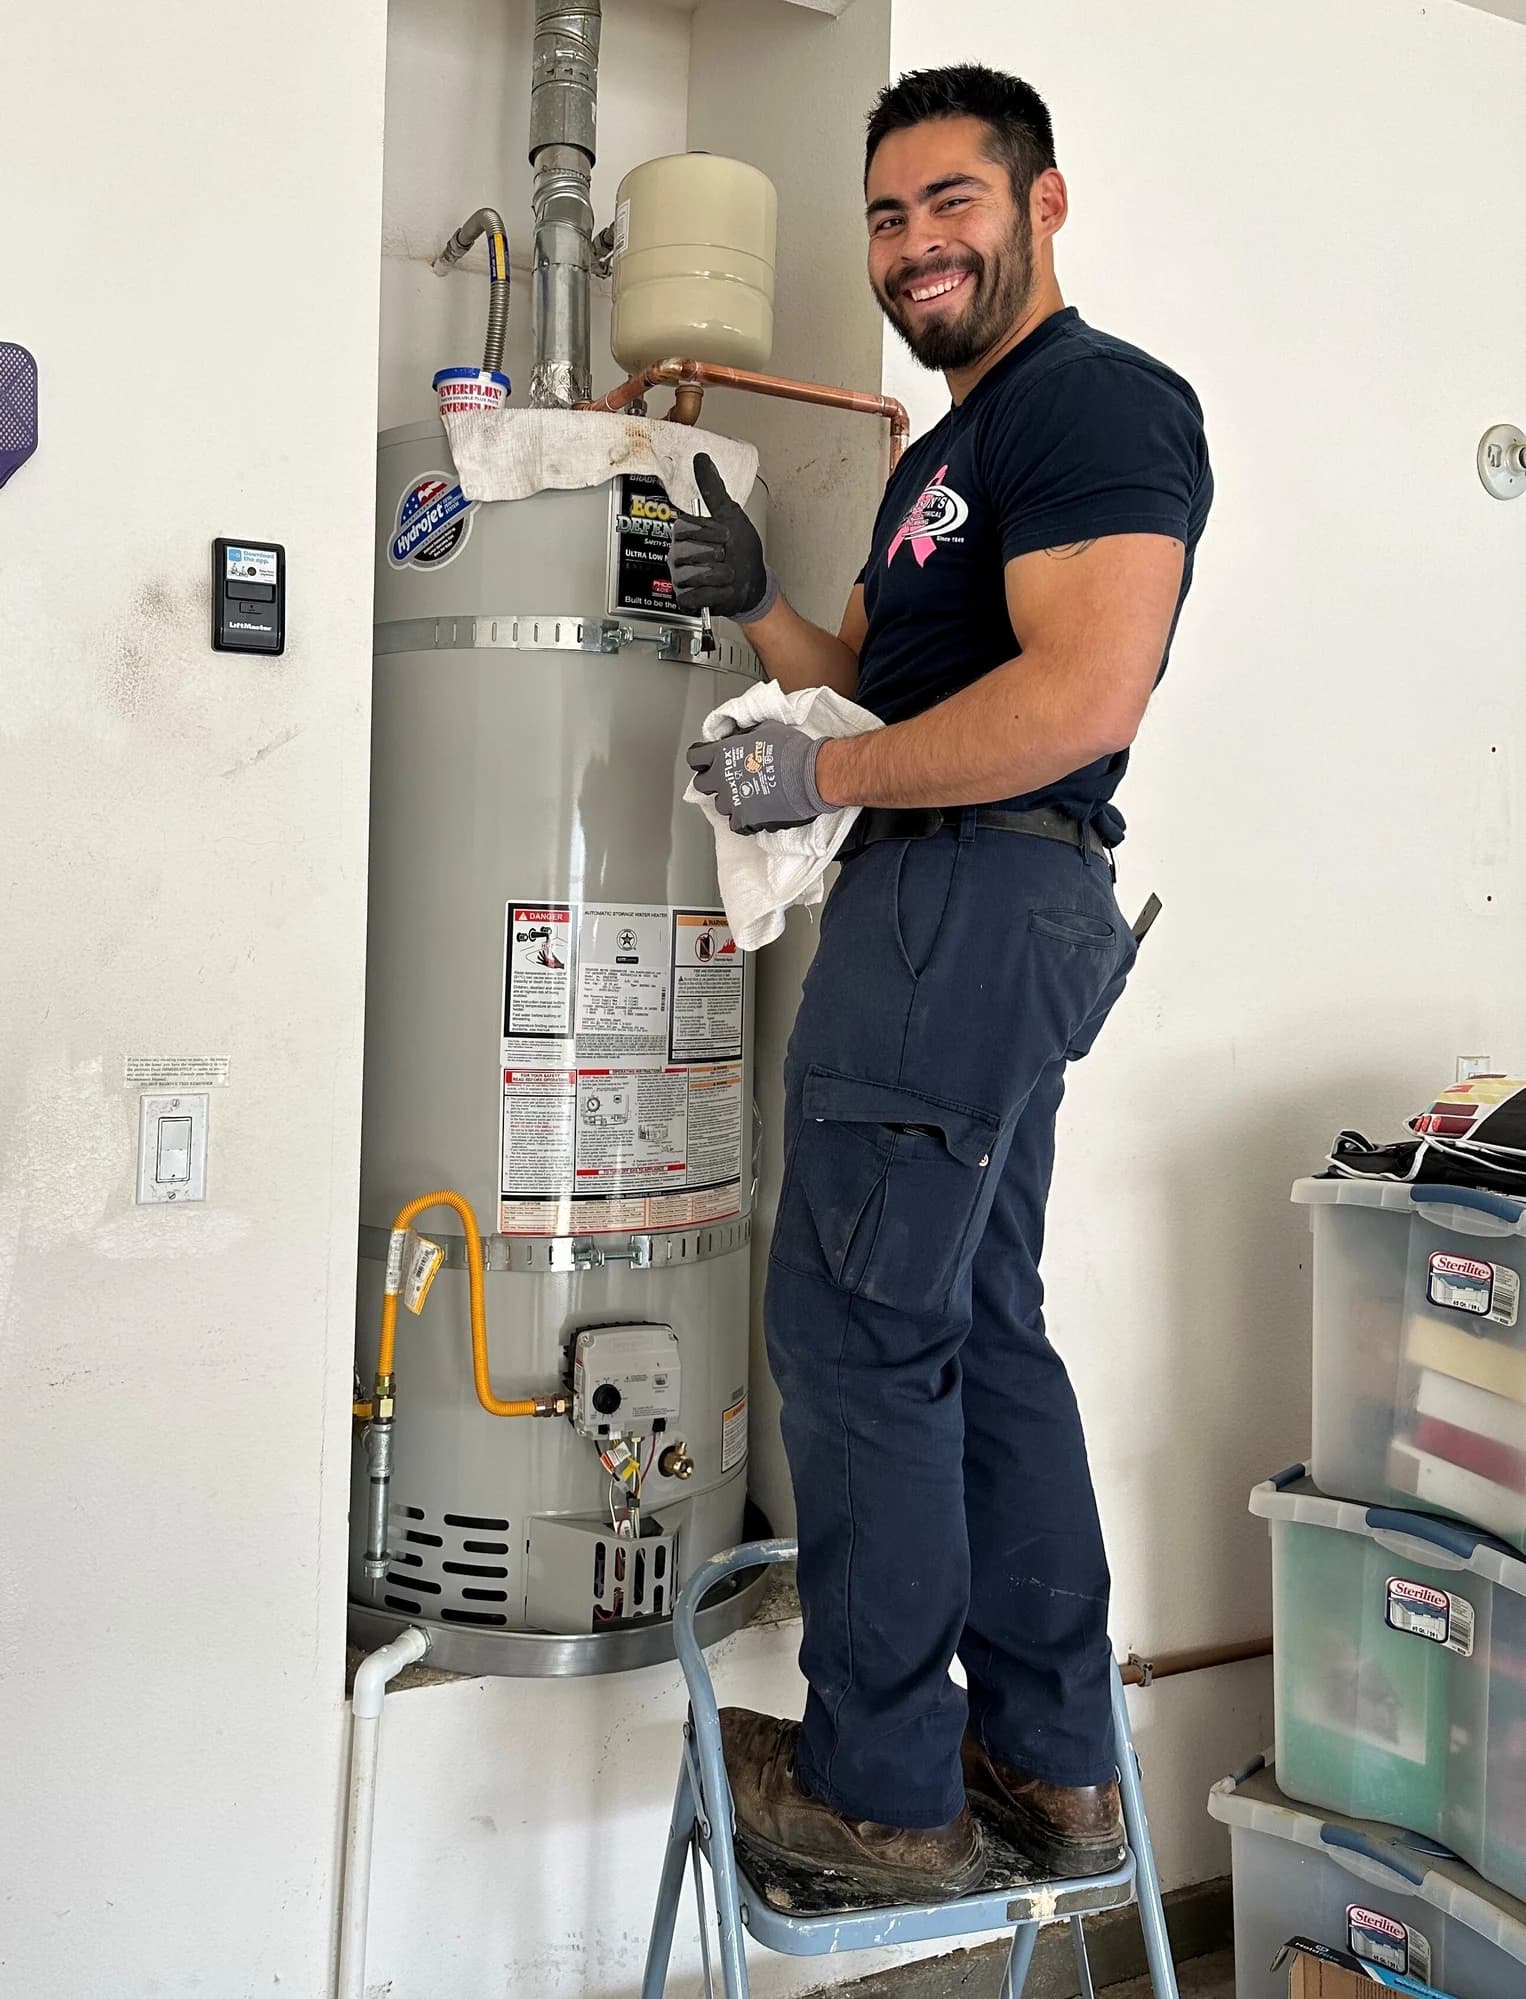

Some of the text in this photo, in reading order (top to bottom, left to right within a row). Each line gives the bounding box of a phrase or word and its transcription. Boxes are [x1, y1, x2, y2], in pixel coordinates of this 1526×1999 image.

[397, 503, 444, 554] Hydrojet
[616, 515, 673, 538] DEFEN
[625, 595, 642, 604] Built
[653, 599, 664, 607] be
[665, 601, 677, 609] the
[229, 621, 273, 631] LiftMaster
[724, 750, 741, 807] MaxiFlex
[529, 912, 563, 921] DANGER
[1437, 1257, 1485, 1277] Sterilite
[1395, 1582, 1442, 1604] Sterilite
[1355, 1910, 1401, 1936] Sterilite
